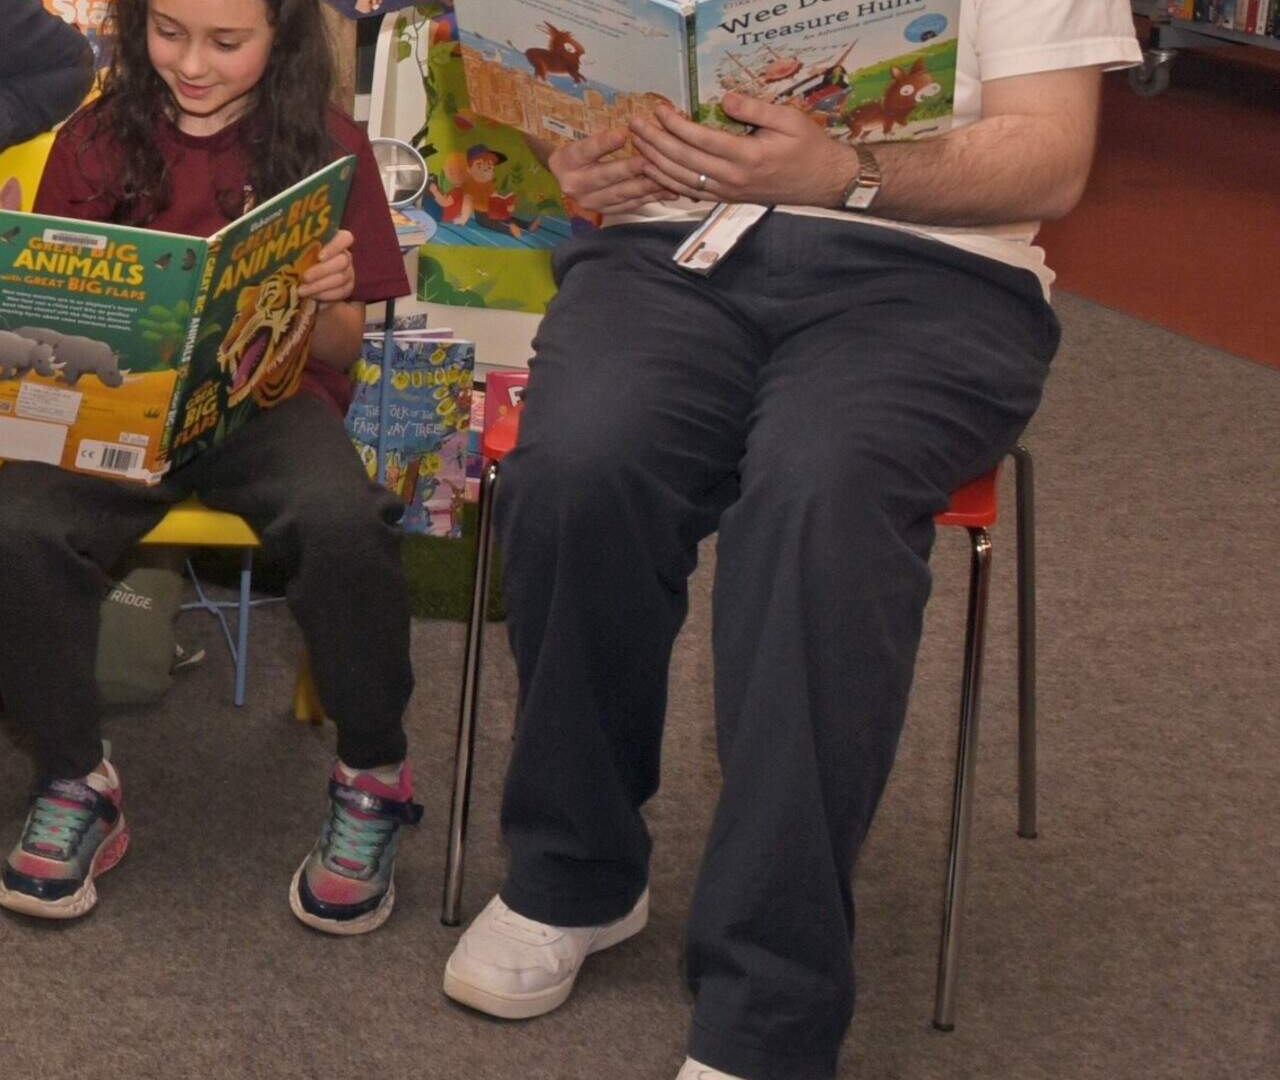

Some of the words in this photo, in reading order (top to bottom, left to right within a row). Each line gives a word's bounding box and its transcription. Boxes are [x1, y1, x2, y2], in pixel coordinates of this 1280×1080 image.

[718, 3, 788, 35] Wee
[736, 10, 850, 47] Treasure
[231, 216, 287, 262] GREAT
[286, 183, 329, 223] BIG
[12, 248, 145, 286] ANIMALS
[212, 205, 332, 300] ANIMALS
[23, 275, 65, 288] GREAT
[67, 277, 102, 294] BIG
[104, 286, 147, 301] FLAPS
[184, 395, 220, 428] BIG
[414, 421, 442, 436] TREE
